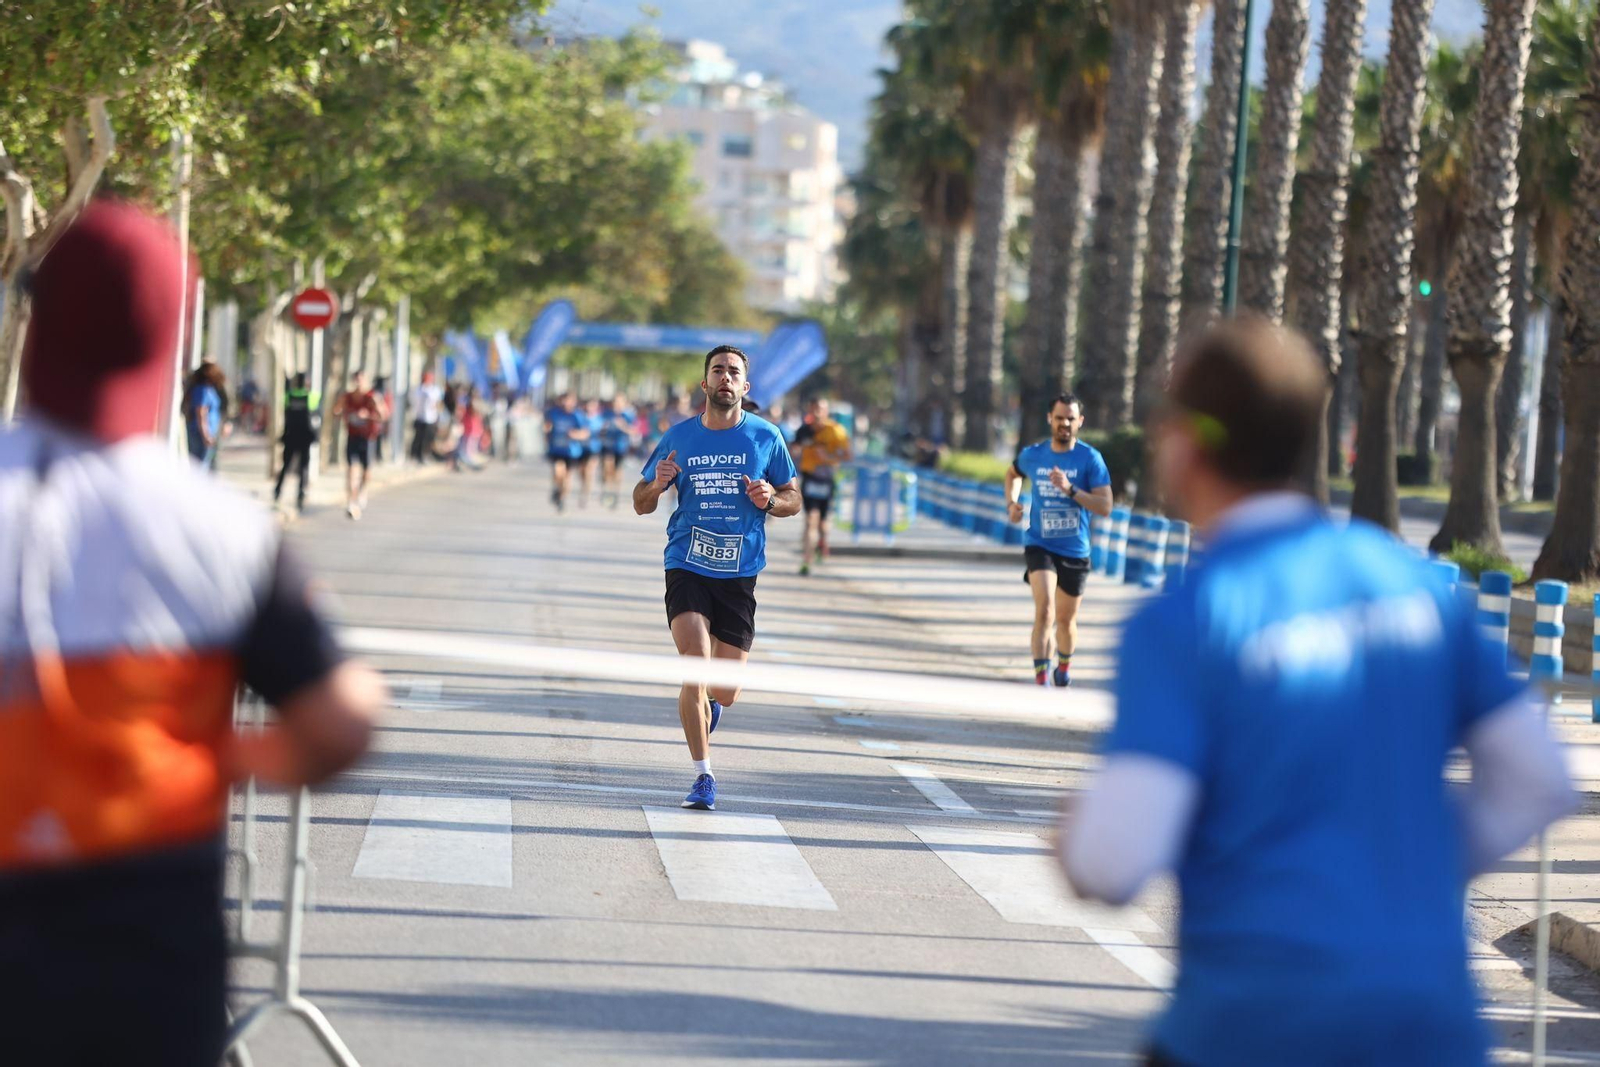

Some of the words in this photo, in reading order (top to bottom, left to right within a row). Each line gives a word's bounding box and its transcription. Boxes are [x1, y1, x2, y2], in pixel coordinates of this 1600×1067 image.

[687, 453, 746, 466] mayoral
[689, 472, 742, 482] RUNNING
[1037, 468, 1078, 478] maral
[694, 480, 738, 488] MAKES
[695, 487, 740, 495] FRIENDS
[697, 543, 735, 559] 1983
